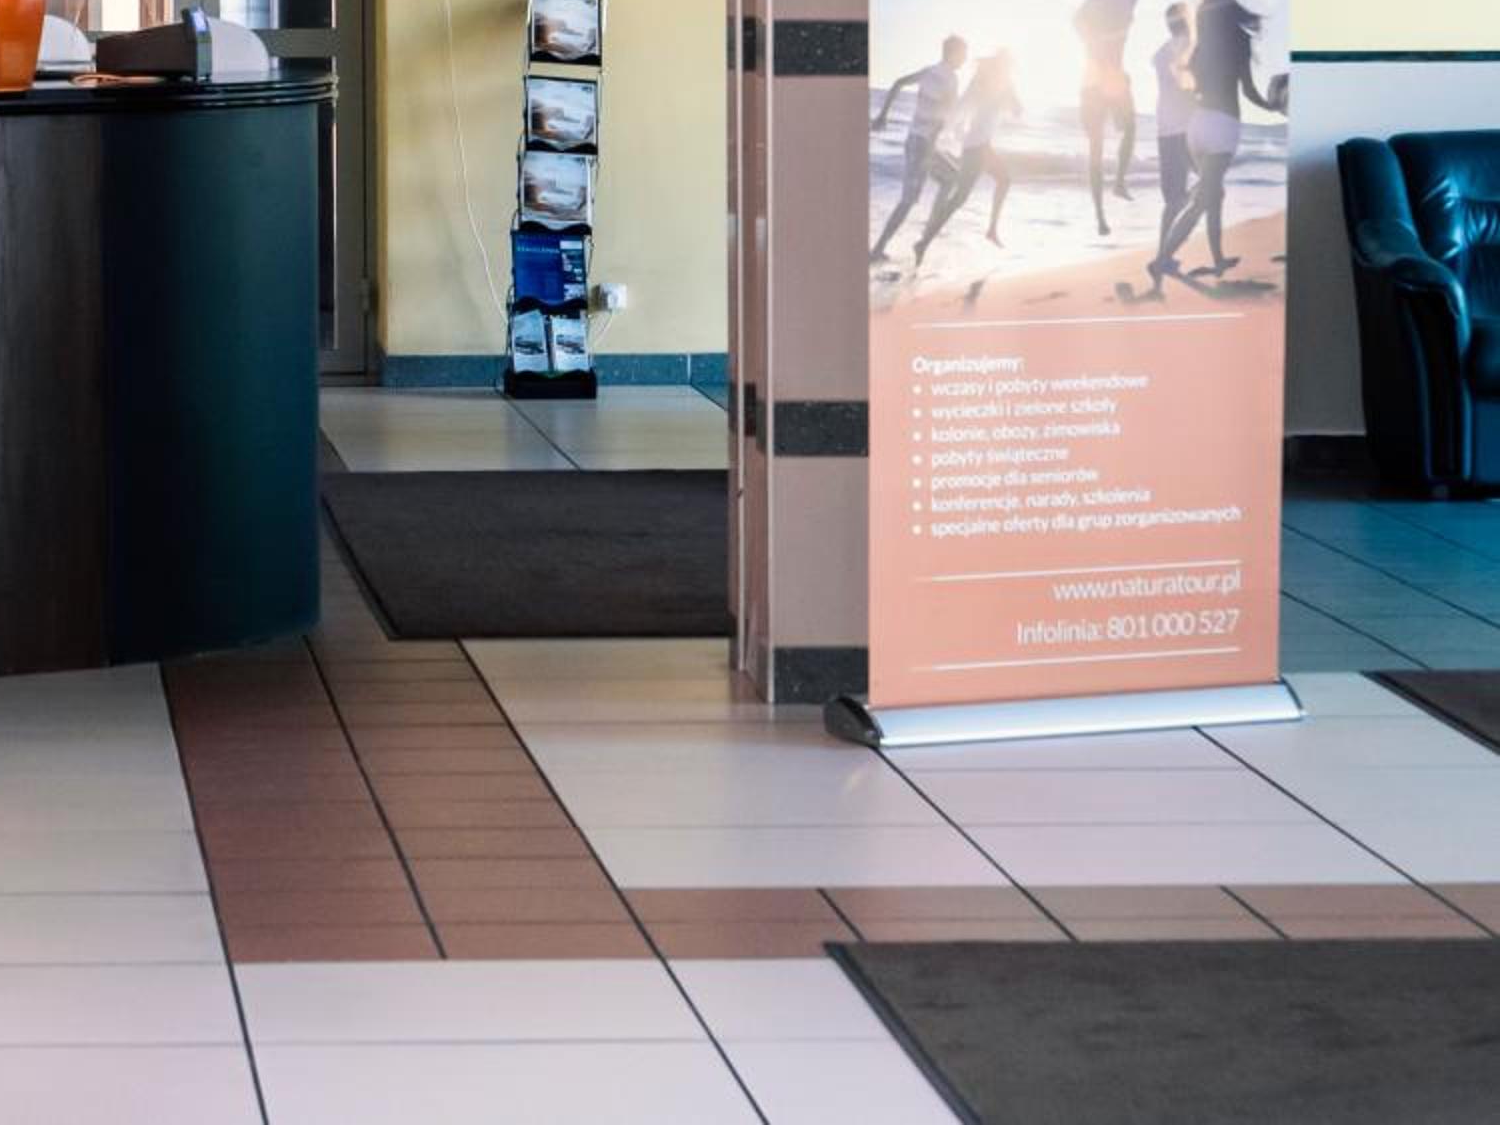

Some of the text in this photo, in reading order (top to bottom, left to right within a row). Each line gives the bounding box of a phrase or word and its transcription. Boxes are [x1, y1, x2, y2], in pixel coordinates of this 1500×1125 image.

[911, 355, 1025, 376] Organizujemy:
[995, 375, 1048, 397] pobyty
[1050, 373, 1151, 391] weekendowe
[1002, 513, 1050, 534] oferty
[1077, 512, 1113, 532] grup
[1114, 502, 1243, 528] zorganizowanych
[1052, 567, 1242, 601] www.naturatour.pl
[1016, 607, 1242, 646] Infolinia: 801 000 527
